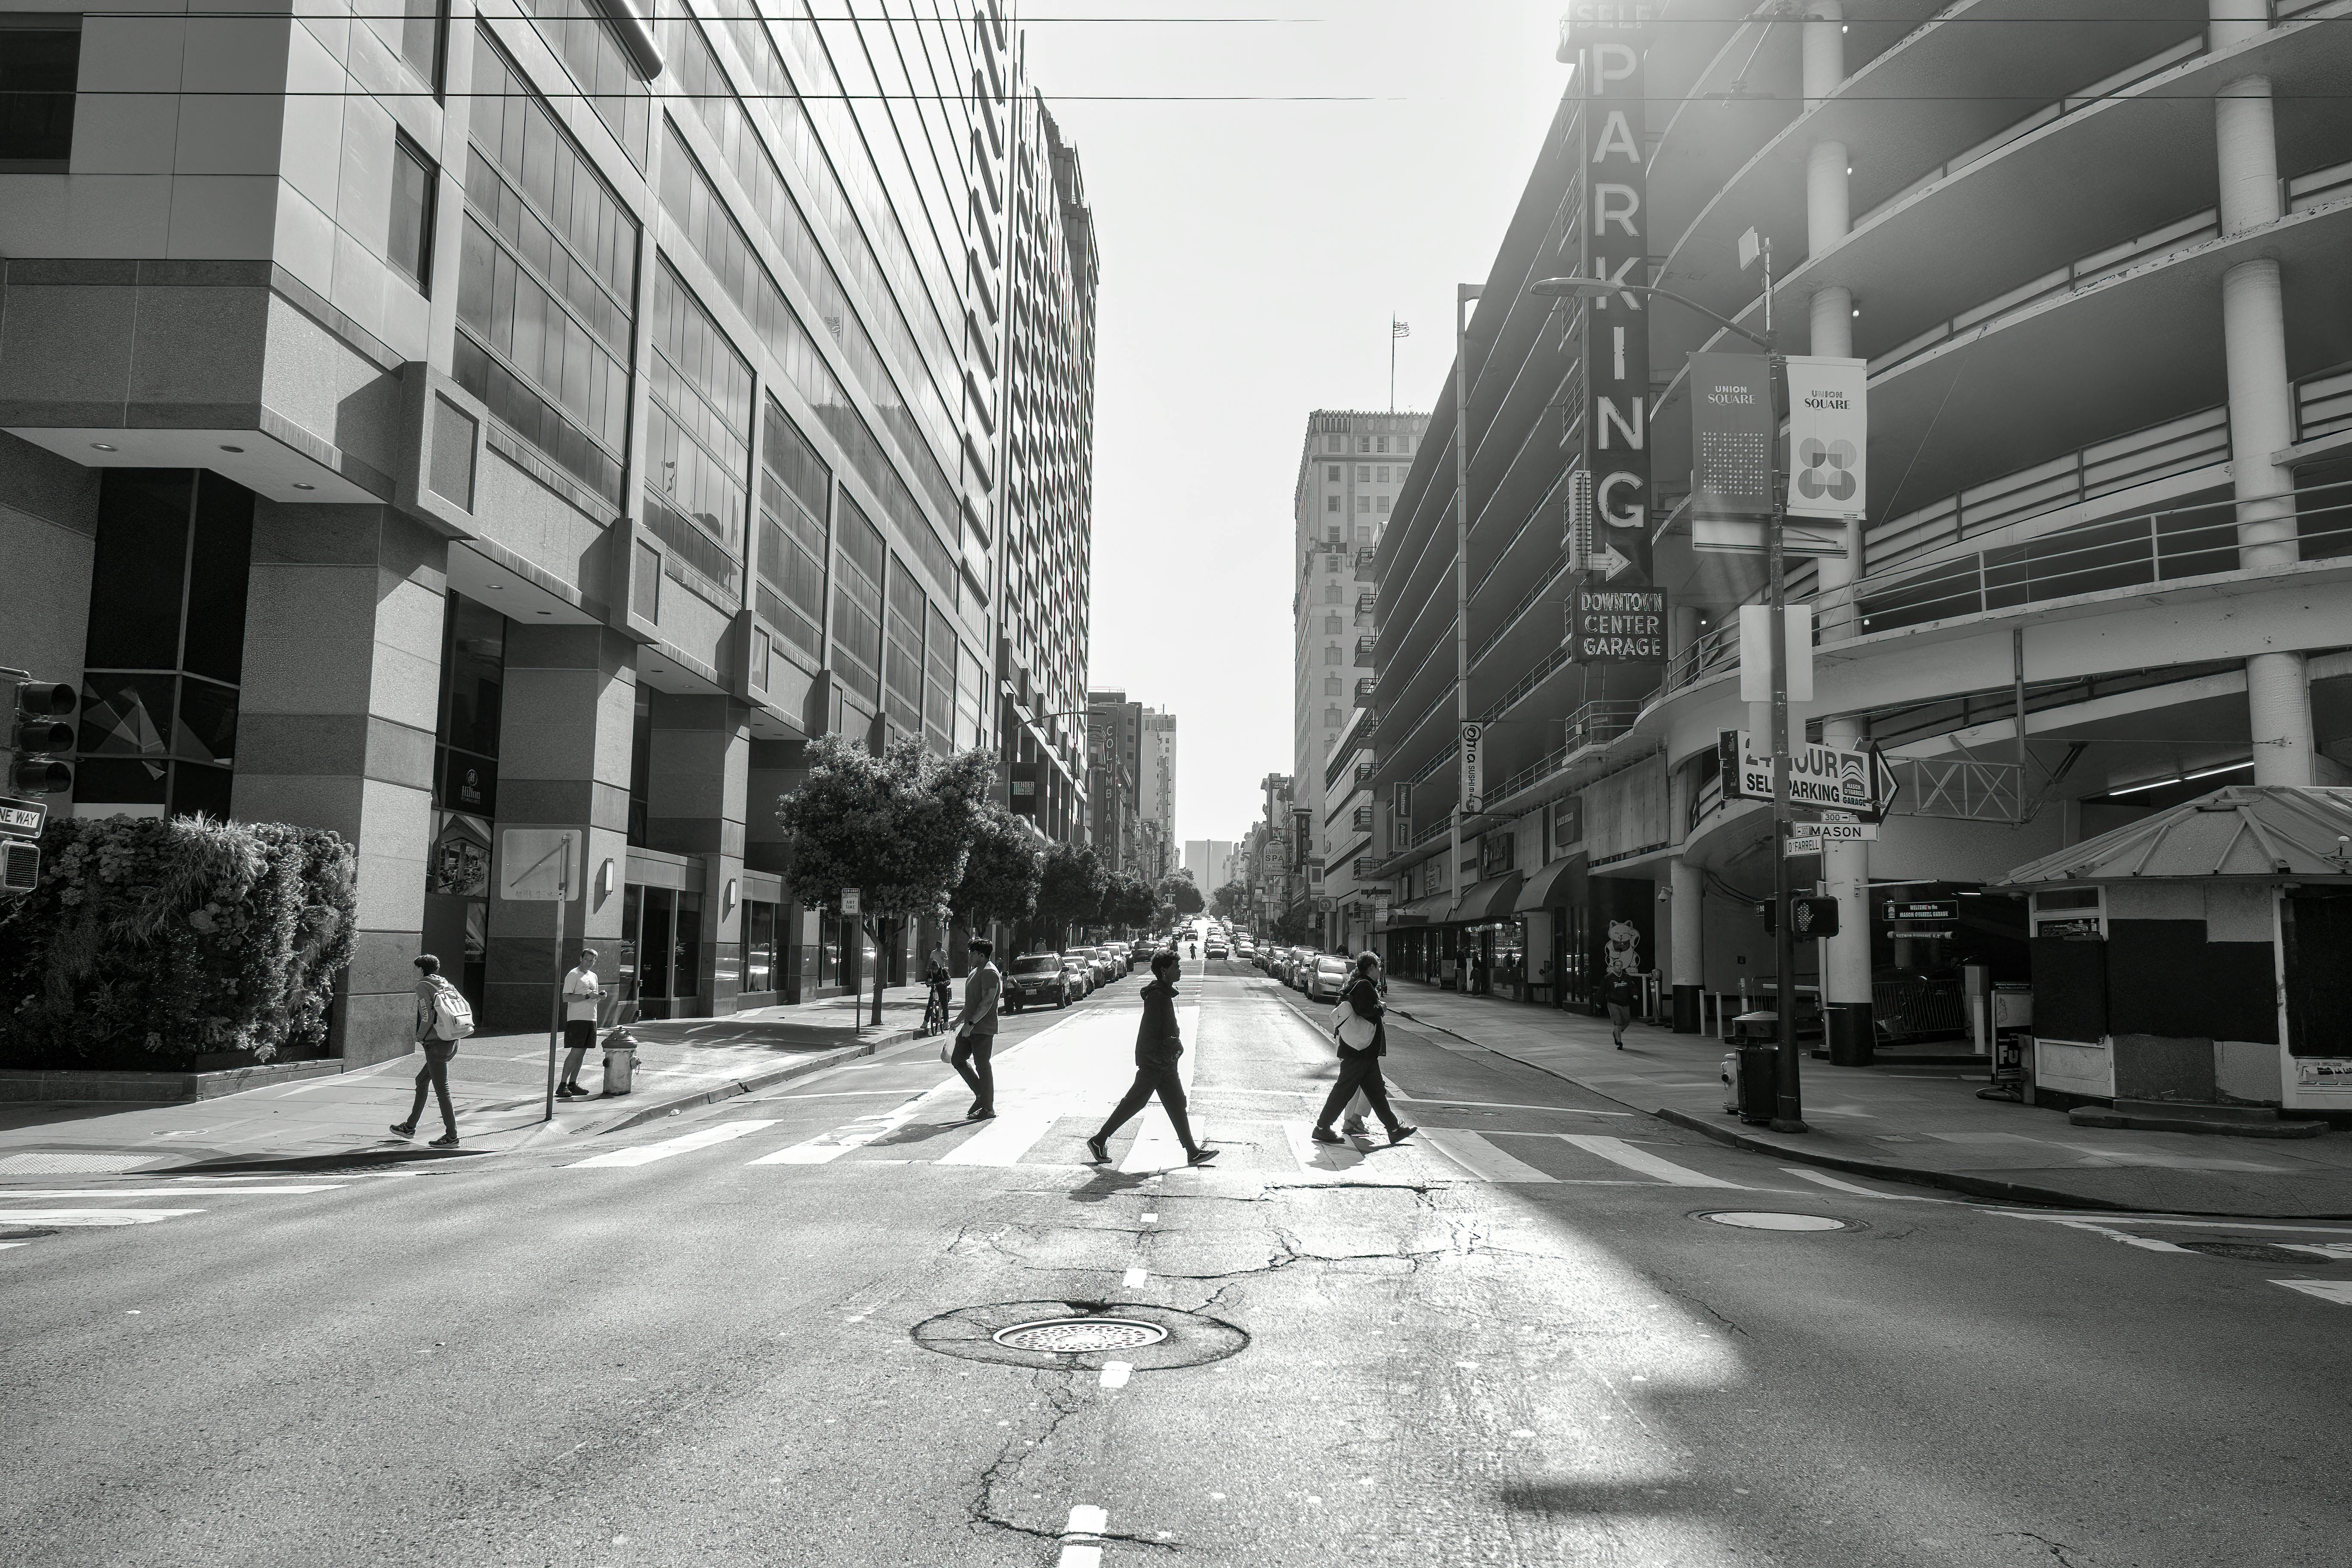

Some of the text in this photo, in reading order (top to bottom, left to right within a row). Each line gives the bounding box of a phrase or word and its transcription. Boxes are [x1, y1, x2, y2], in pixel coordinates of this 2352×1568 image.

[1577, 4, 1651, 29] SELF
[1592, 43, 1644, 528] PARKING
[1708, 394, 1755, 405] SQUARE
[1811, 390, 1843, 398] UNION
[1805, 398, 1850, 410] SQUARE
[1581, 592, 1663, 612] DOWNTOWN
[1585, 615, 1660, 634] CENTER
[1583, 637, 1661, 655] GARAGE
[1786, 748, 1838, 778] OUR
[1105, 726, 1114, 823] COLUMBIA
[1747, 773, 1774, 793] SEL
[462, 785, 480, 799] Hilton
[16, 811, 37, 826] WAY
[1811, 826, 1862, 837] MASON
[1788, 839, 1819, 852] O'FARRELL
